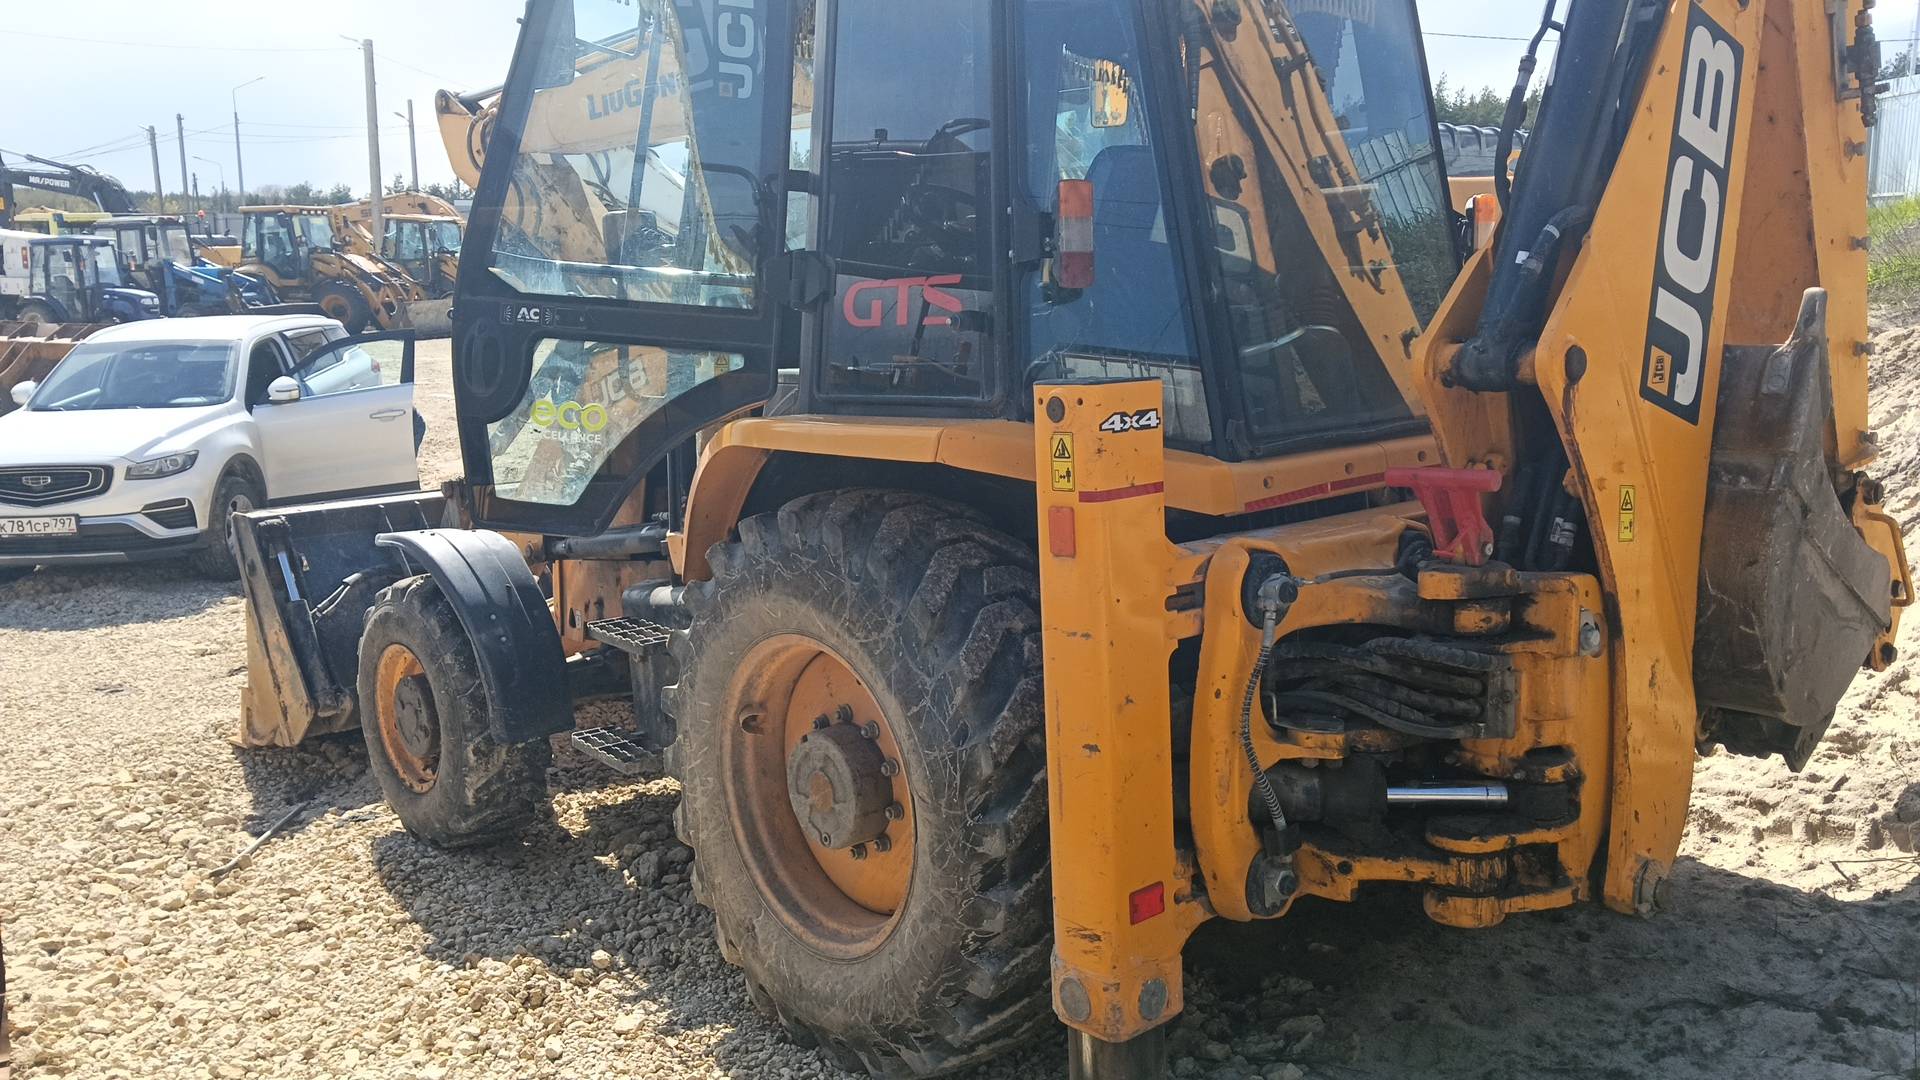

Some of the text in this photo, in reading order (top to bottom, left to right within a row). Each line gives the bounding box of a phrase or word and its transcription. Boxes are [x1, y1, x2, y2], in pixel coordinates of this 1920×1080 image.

[718, 0, 754, 99] JC
[1655, 25, 1735, 406] JCB
[517, 307, 540, 320] AC
[843, 274, 963, 327] GTS
[531, 400, 608, 432] eco
[1100, 409, 1160, 432] 4x4
[52, 517, 73, 528] 797
